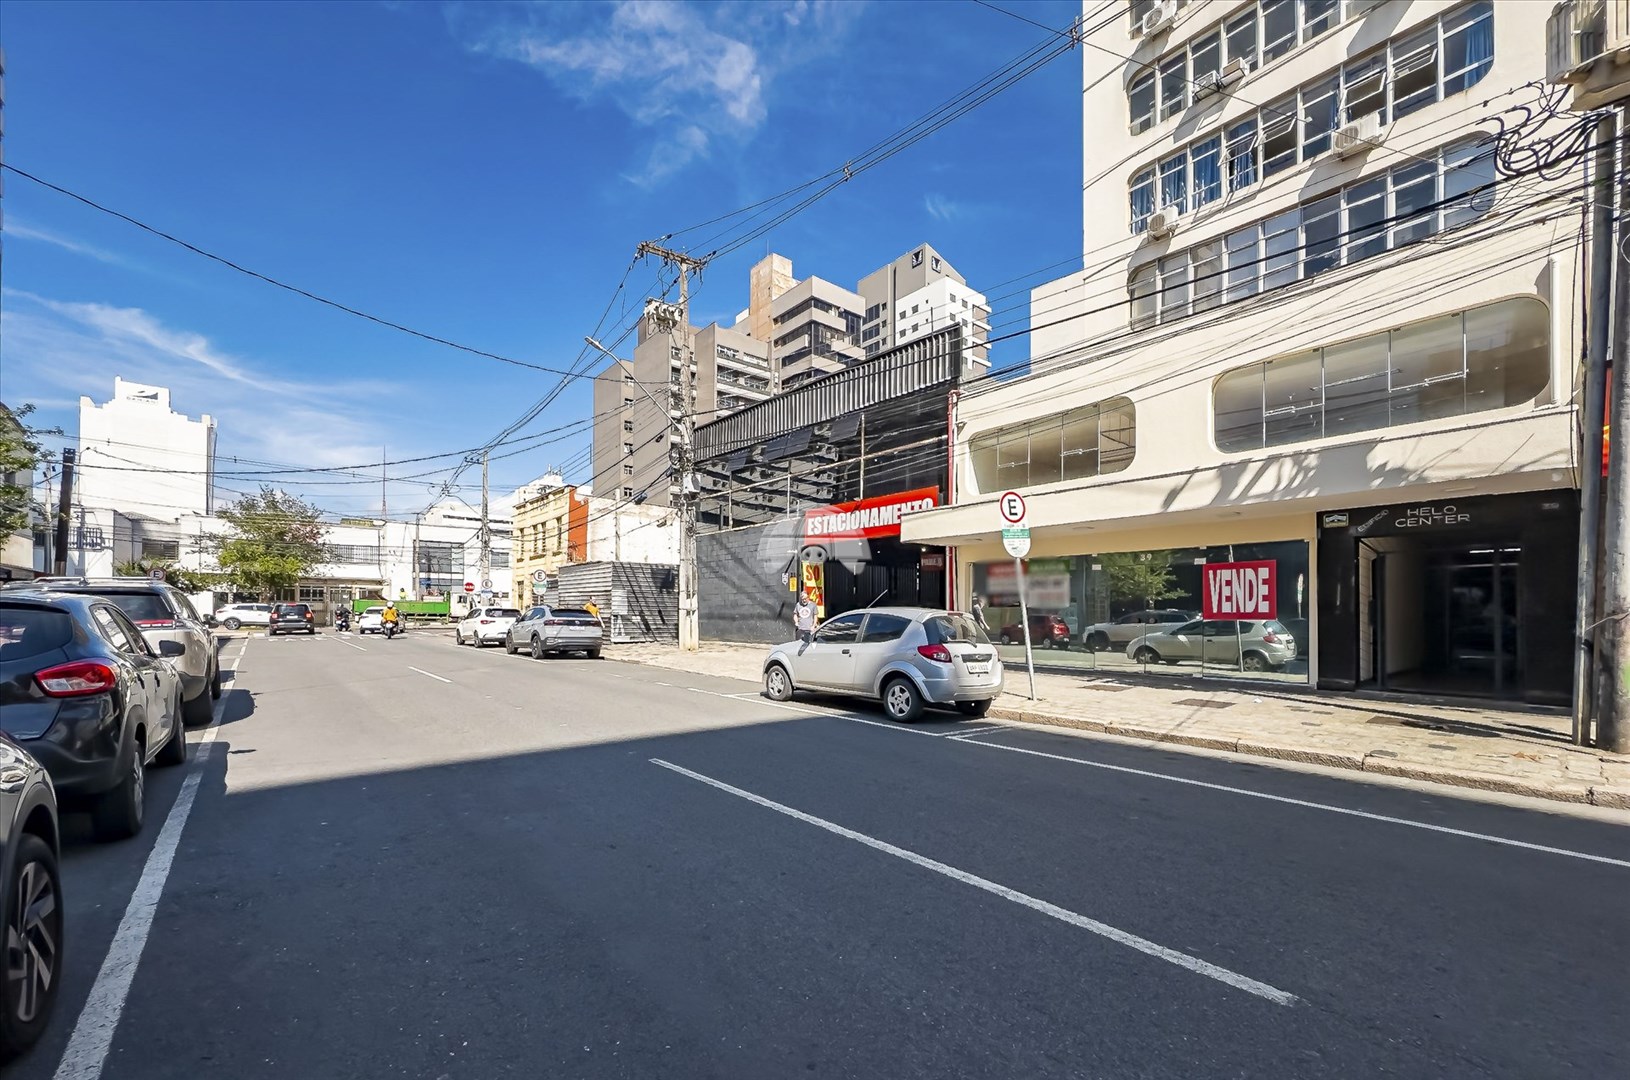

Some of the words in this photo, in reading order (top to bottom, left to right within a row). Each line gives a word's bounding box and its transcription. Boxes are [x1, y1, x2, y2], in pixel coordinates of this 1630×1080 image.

[1007, 498, 1018, 516] E
[1407, 505, 1457, 517] HELO
[807, 498, 934, 535] ESTACIONAMENTO
[1395, 513, 1471, 528] CENTER
[1208, 567, 1270, 614] VENDE
